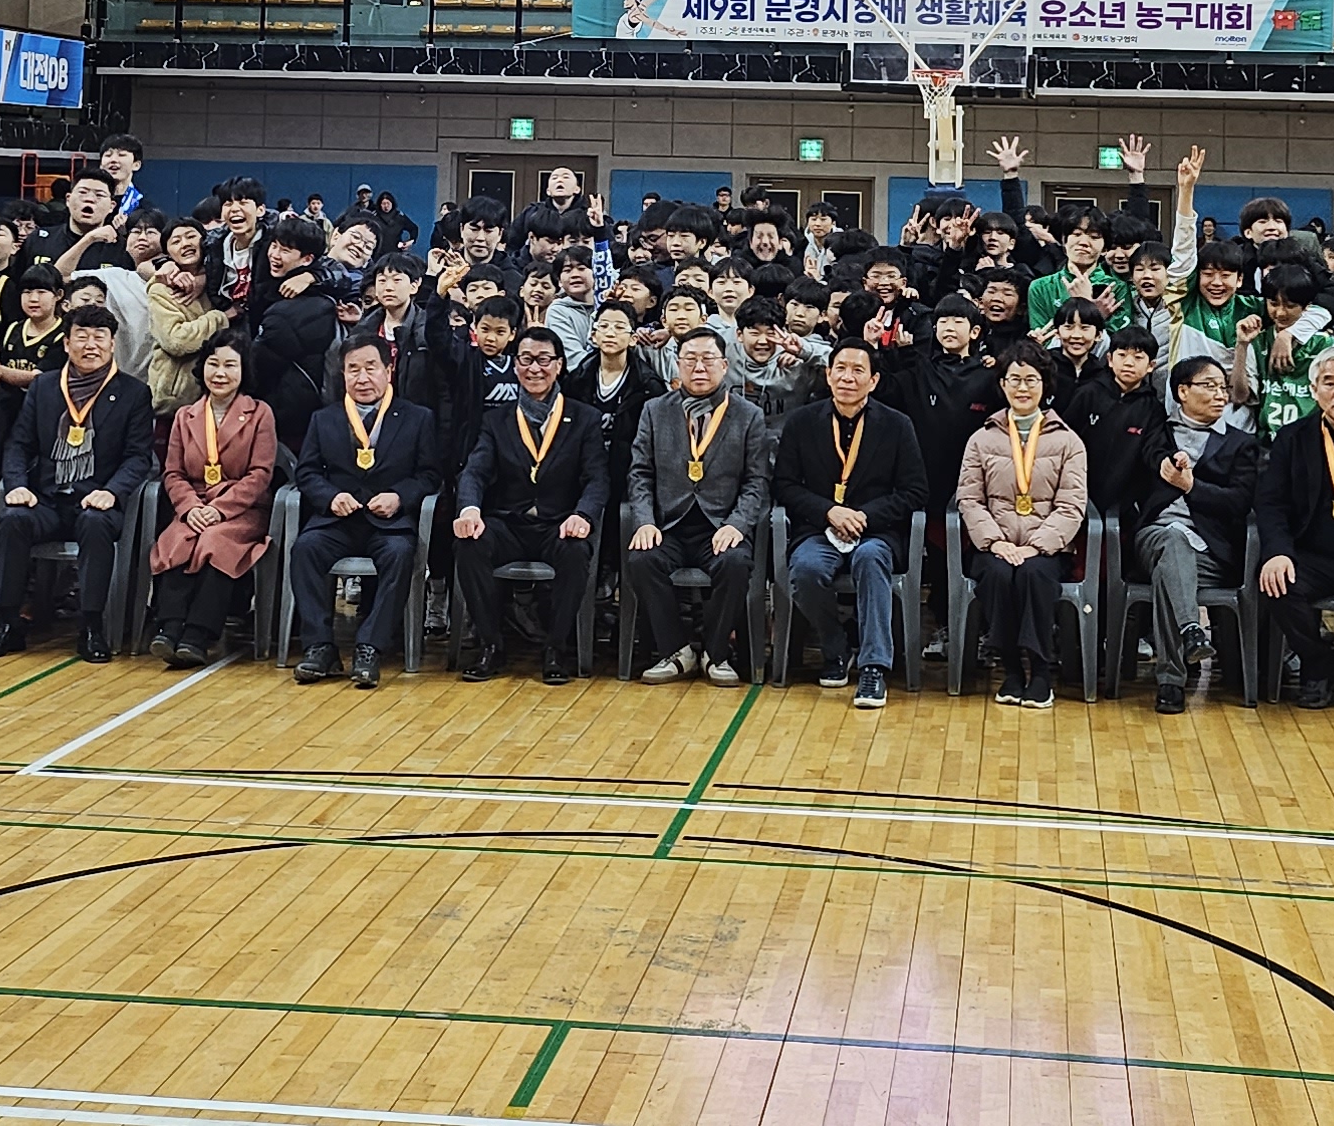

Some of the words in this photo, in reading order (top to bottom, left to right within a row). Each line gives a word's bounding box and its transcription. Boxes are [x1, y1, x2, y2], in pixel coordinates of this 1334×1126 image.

[1039, 0, 1126, 29] 유소년
[1135, 1, 1253, 31] 농구대회
[1214, 35, 1247, 43] molten
[18, 50, 69, 93] 대전DB
[1267, 402, 1299, 426] 20
